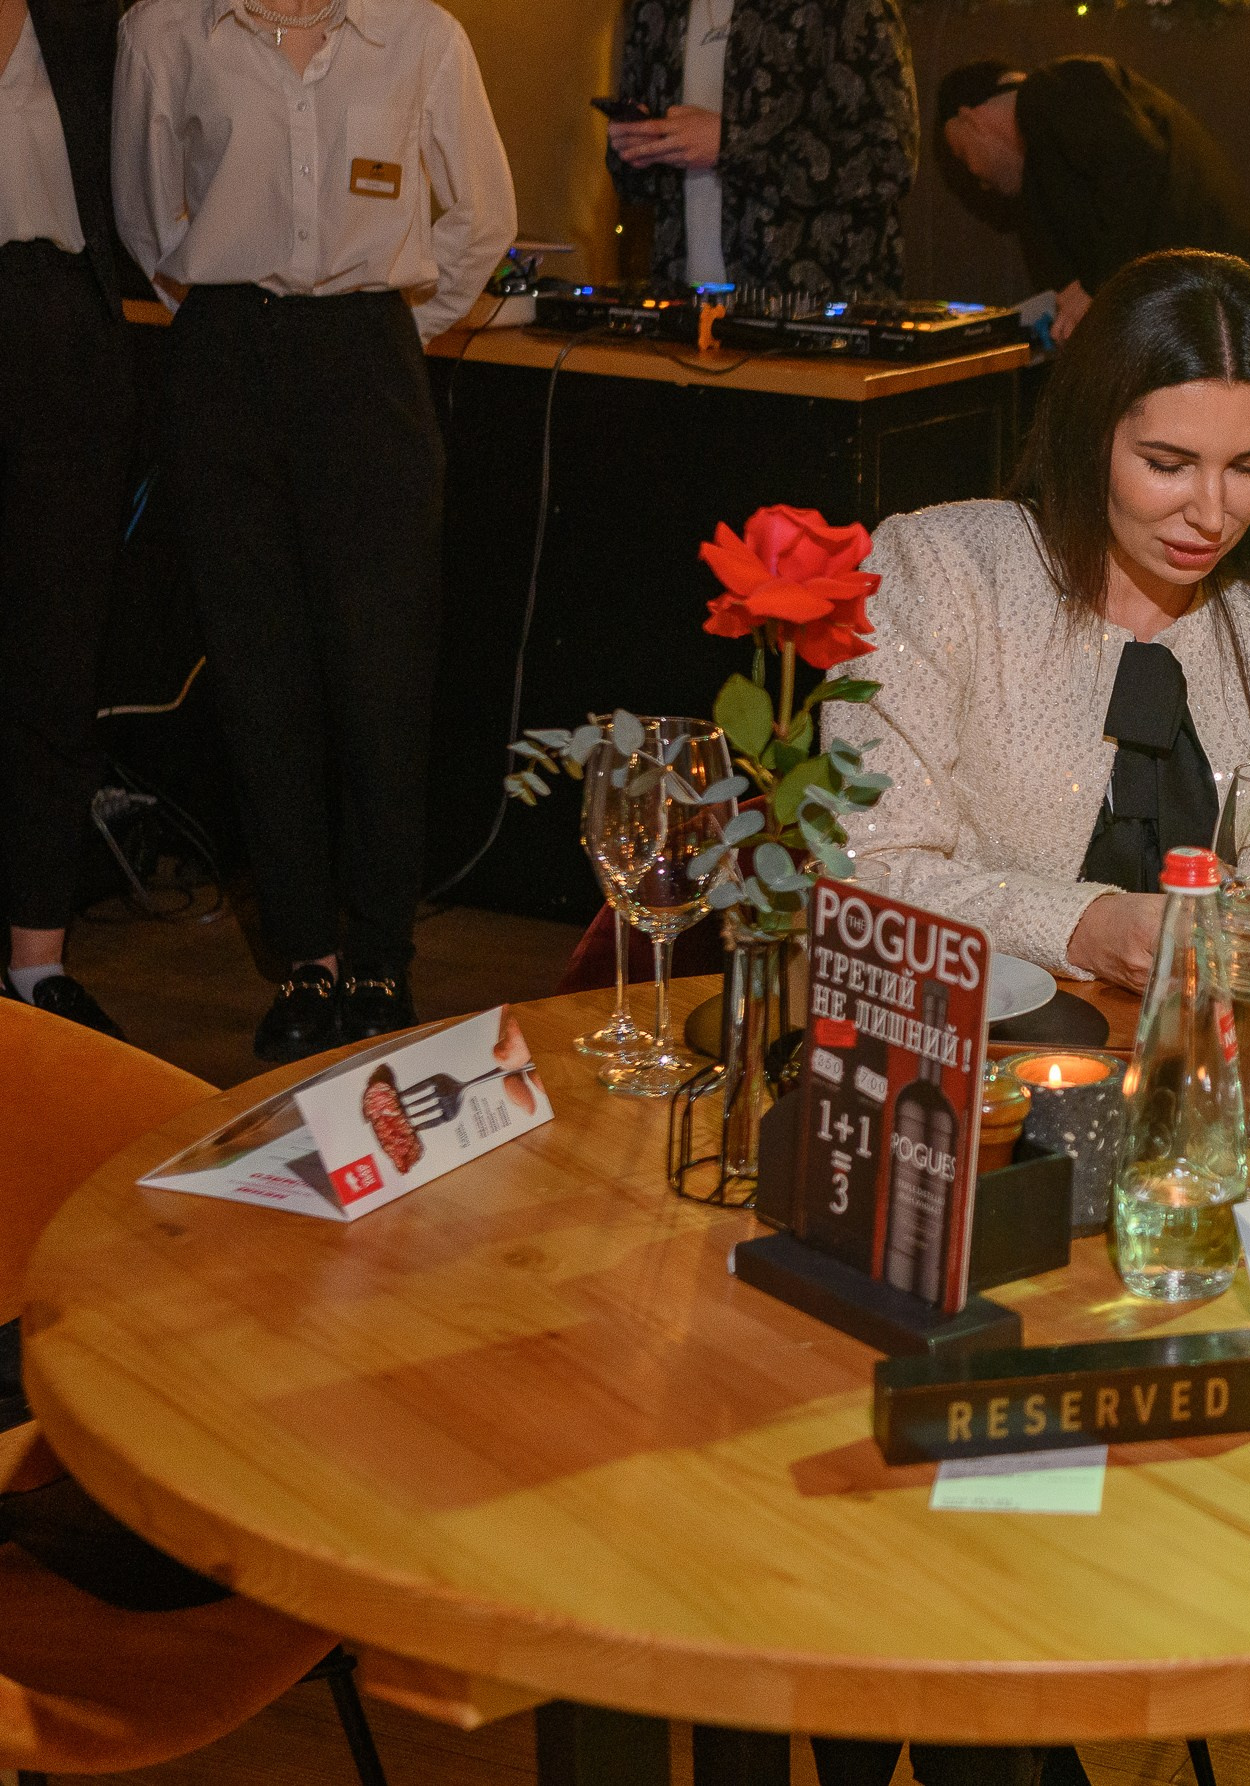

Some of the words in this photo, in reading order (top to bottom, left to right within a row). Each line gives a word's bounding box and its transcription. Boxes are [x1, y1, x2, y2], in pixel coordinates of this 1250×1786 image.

[815, 886, 982, 991] POGUES
[849, 914, 867, 933] THE
[811, 983, 848, 1021] НЕ
[813, 945, 917, 1011] ТРЕТИЙ
[817, 1099, 872, 1159] 1+1
[890, 1131, 957, 1183] POGUES
[829, 1172, 849, 1216] 3
[946, 1376, 1231, 1444] RESERVED
